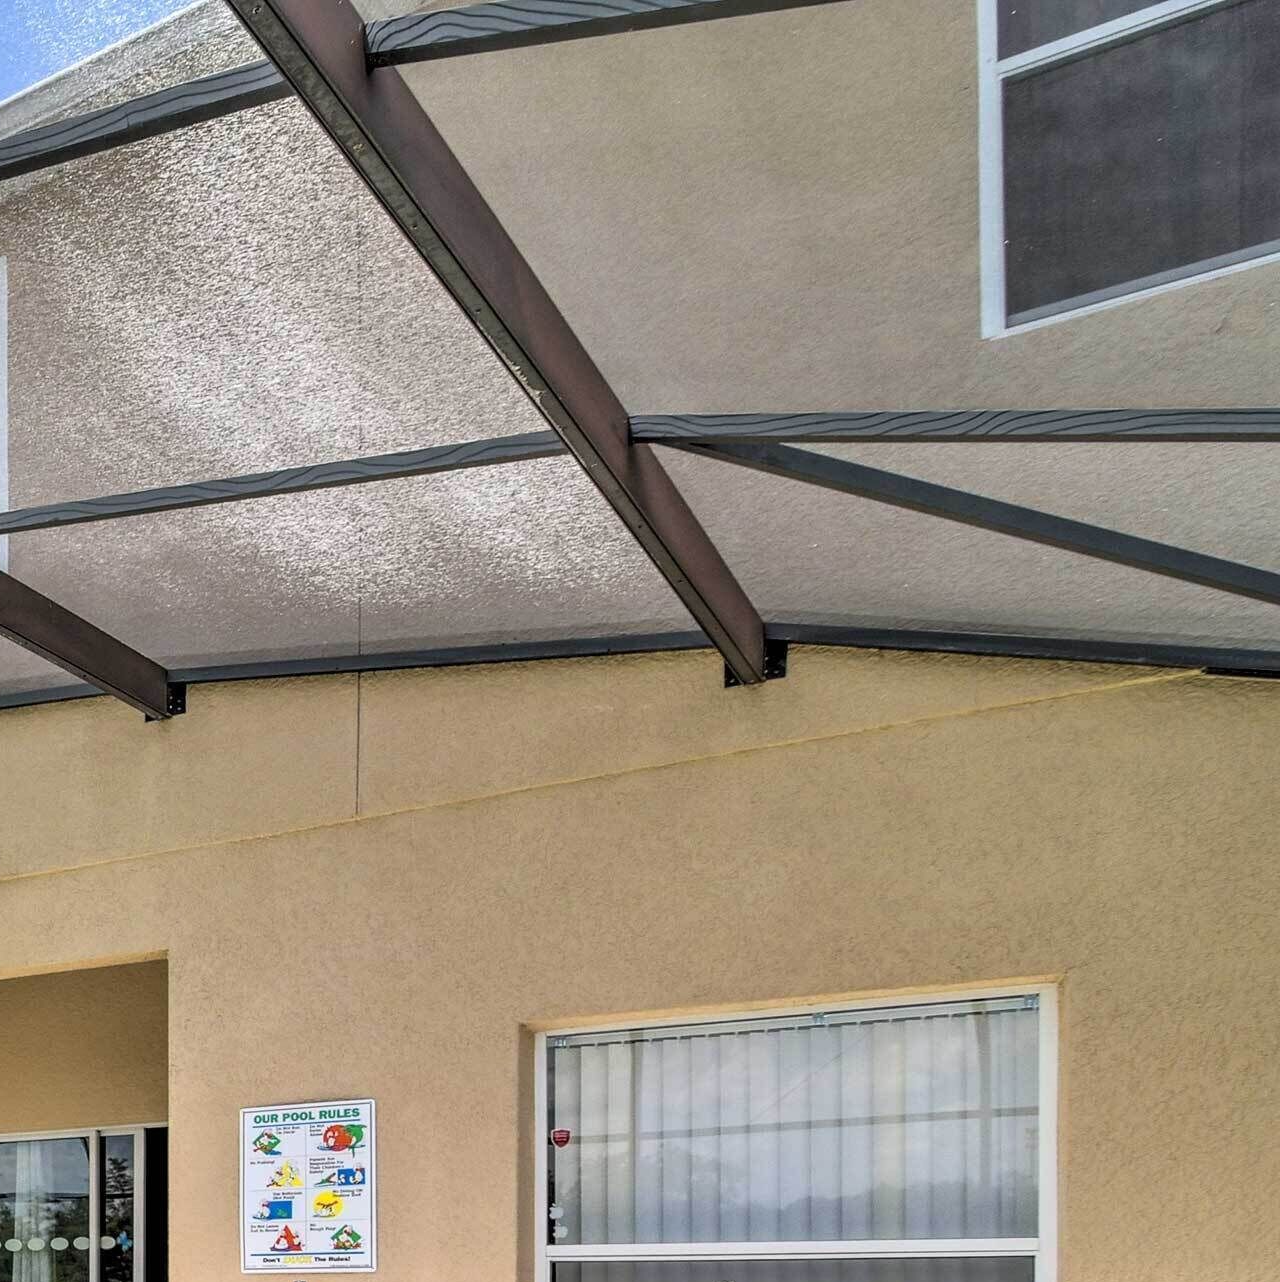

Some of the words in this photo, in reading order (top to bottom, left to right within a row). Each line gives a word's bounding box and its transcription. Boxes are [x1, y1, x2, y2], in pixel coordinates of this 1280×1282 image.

[254, 1114, 279, 1124] OUR
[282, 1111, 316, 1123] POOL
[319, 1108, 360, 1120] RULES
